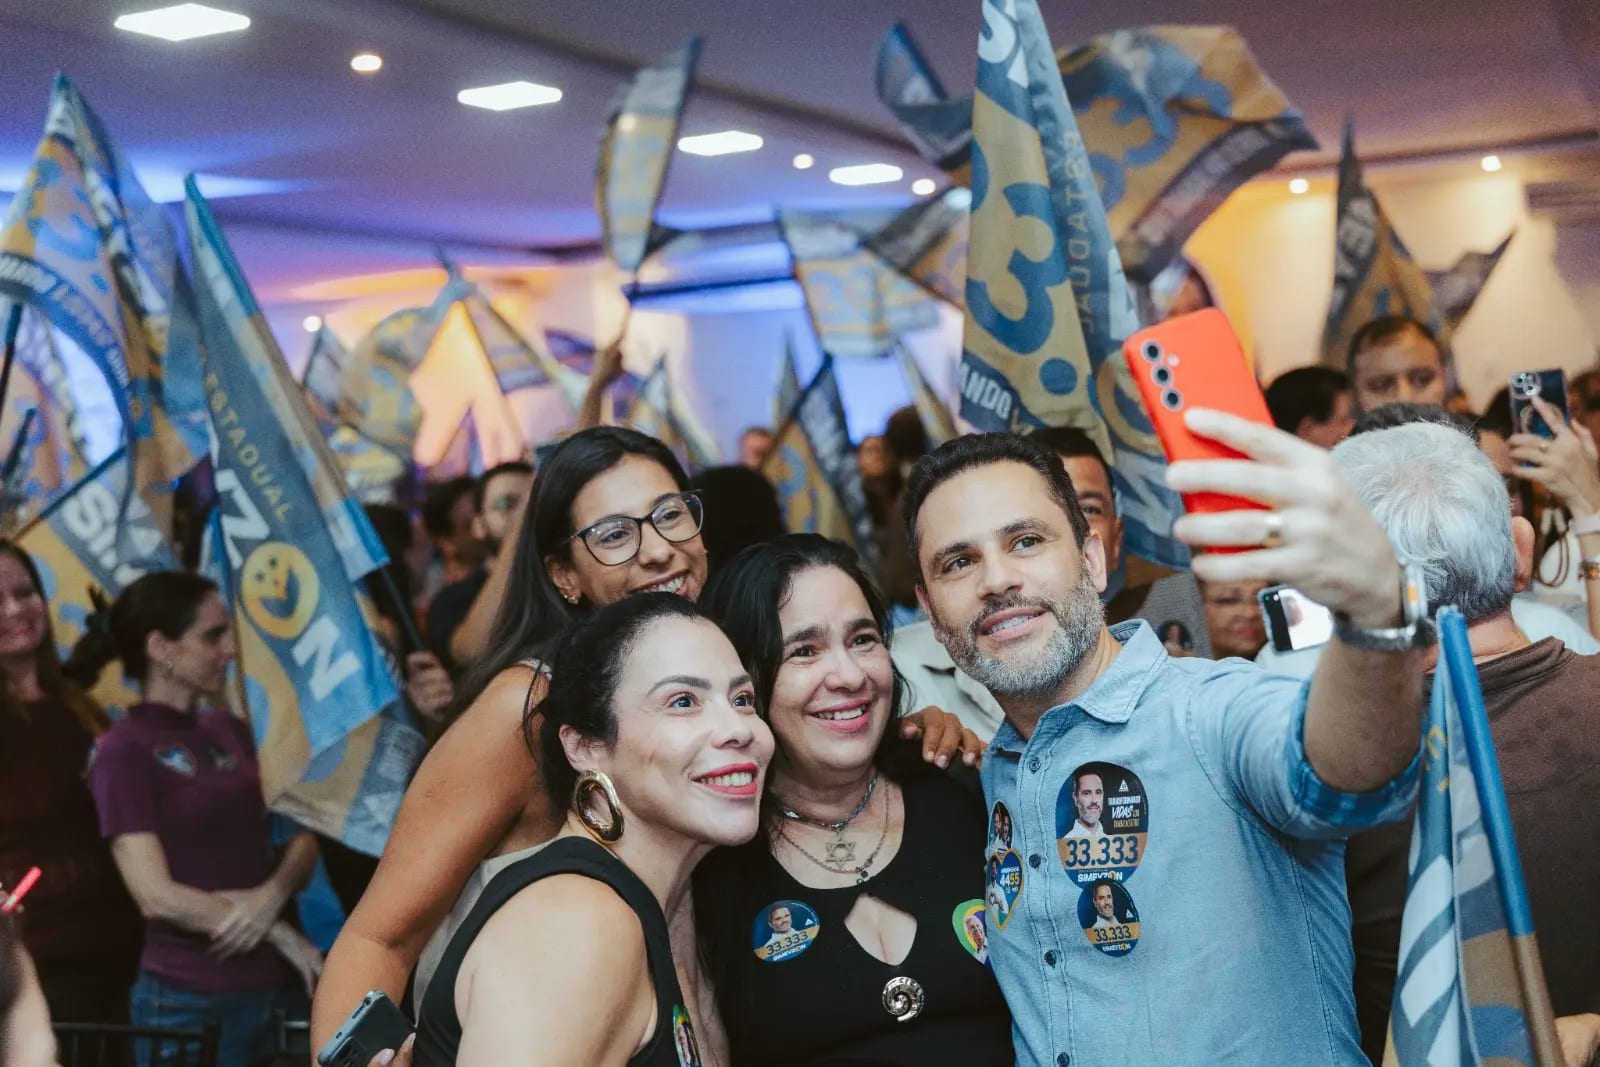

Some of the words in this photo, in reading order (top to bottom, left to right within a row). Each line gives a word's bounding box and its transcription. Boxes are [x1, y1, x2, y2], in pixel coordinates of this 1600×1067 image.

[1111, 804, 1134, 819] VIDAS
[1065, 835, 1139, 868] 33.333
[766, 930, 809, 956] 33.333
[1093, 924, 1131, 942] 33.333
